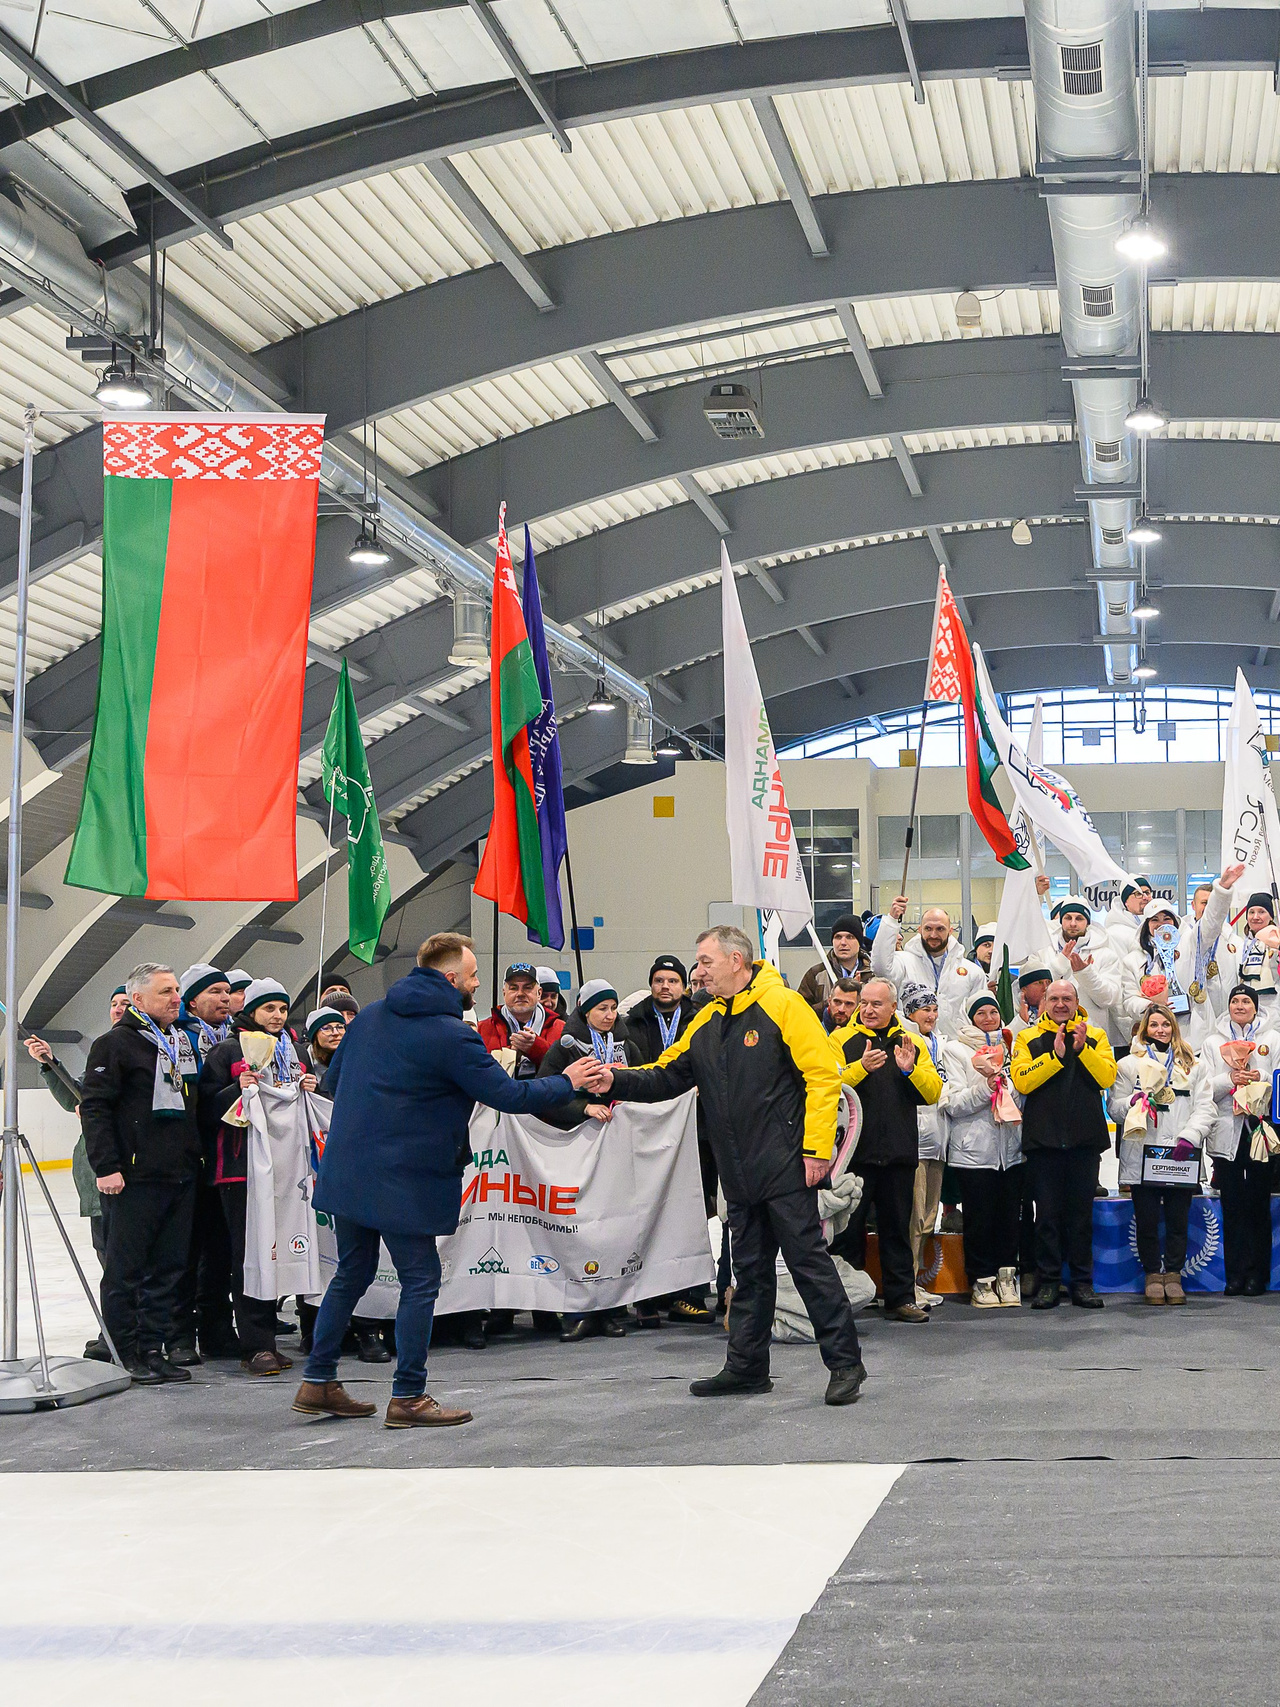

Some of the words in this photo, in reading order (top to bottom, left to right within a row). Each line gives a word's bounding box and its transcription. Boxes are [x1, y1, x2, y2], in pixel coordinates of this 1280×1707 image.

[1151, 1164, 1191, 1172] СЕРТИФИКАТ
[460, 1172, 580, 1216] ИНЫЕ
[488, 1212, 505, 1222] МЫ
[507, 1214, 579, 1234] НЕПОБЕДИМЫ!
